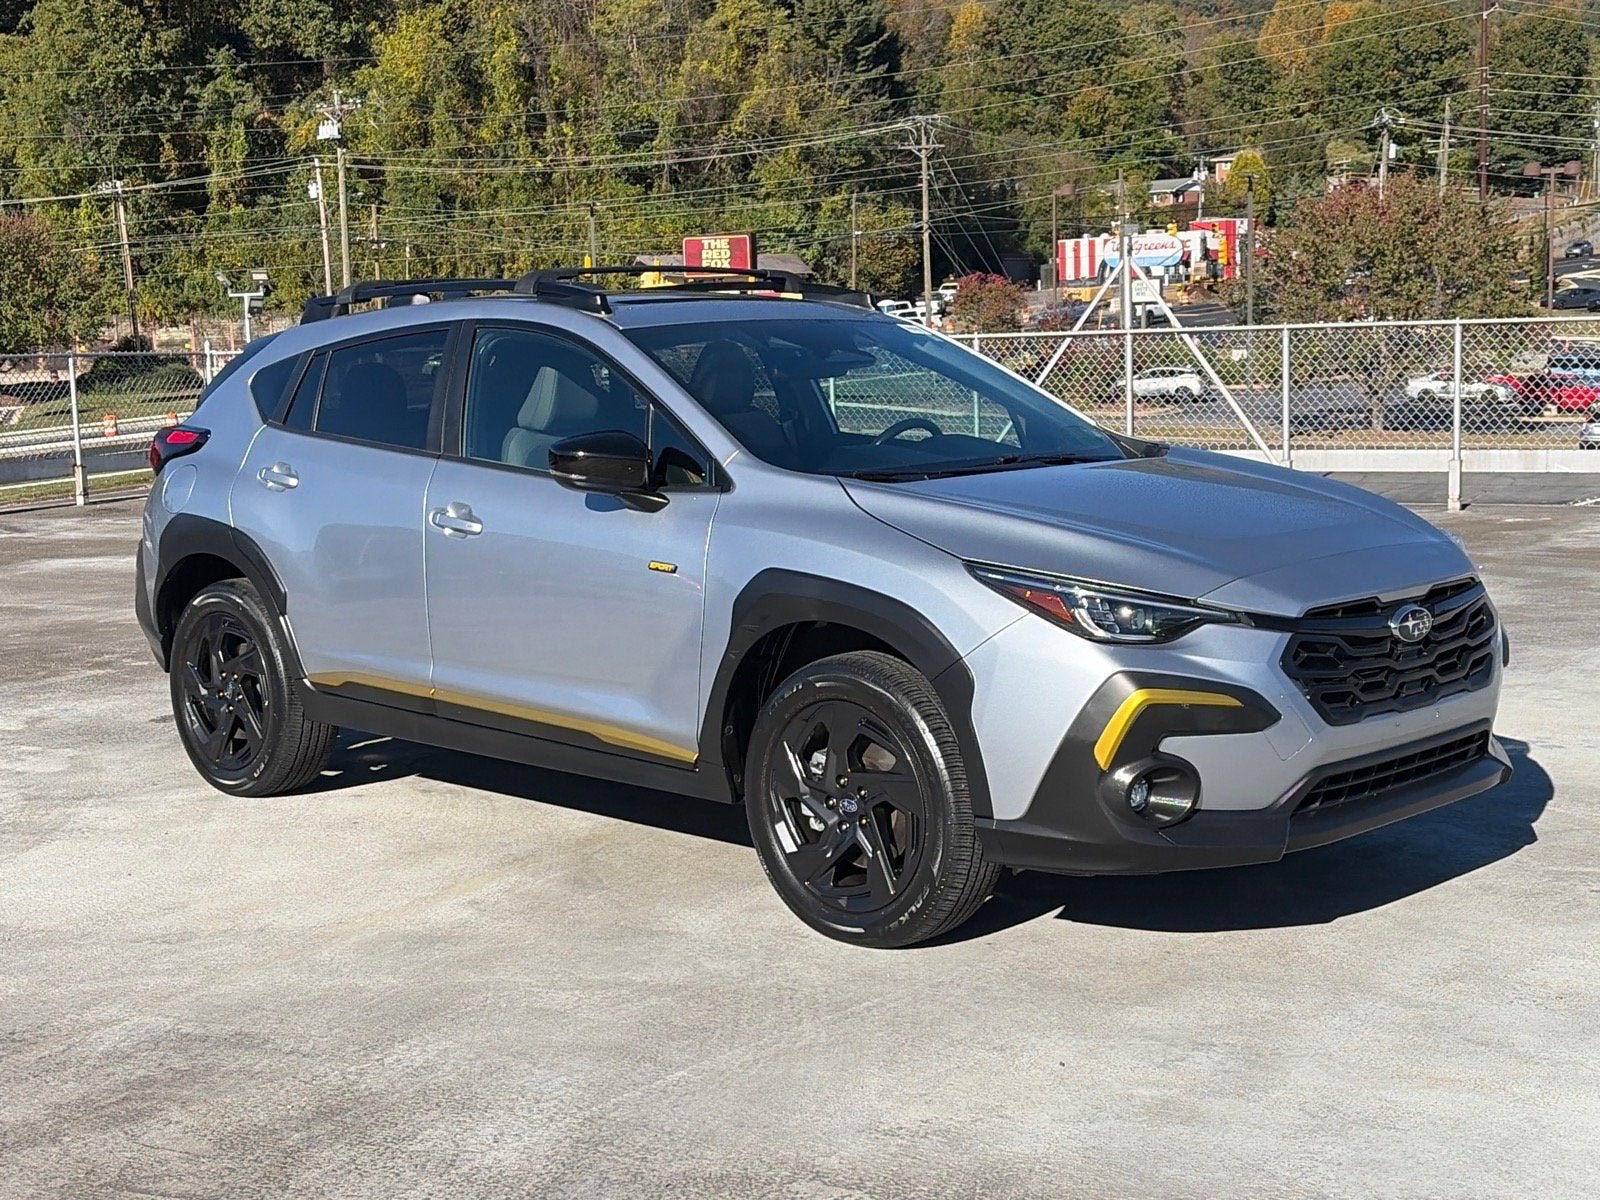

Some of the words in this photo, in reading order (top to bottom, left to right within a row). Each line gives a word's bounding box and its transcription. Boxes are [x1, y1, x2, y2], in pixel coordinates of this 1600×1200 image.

[701, 239, 730, 249] THE
[1111, 239, 1177, 255] Wlgreens
[701, 249, 731, 259] RED
[701, 259, 731, 269] FOX
[649, 561, 676, 573] SPORT
